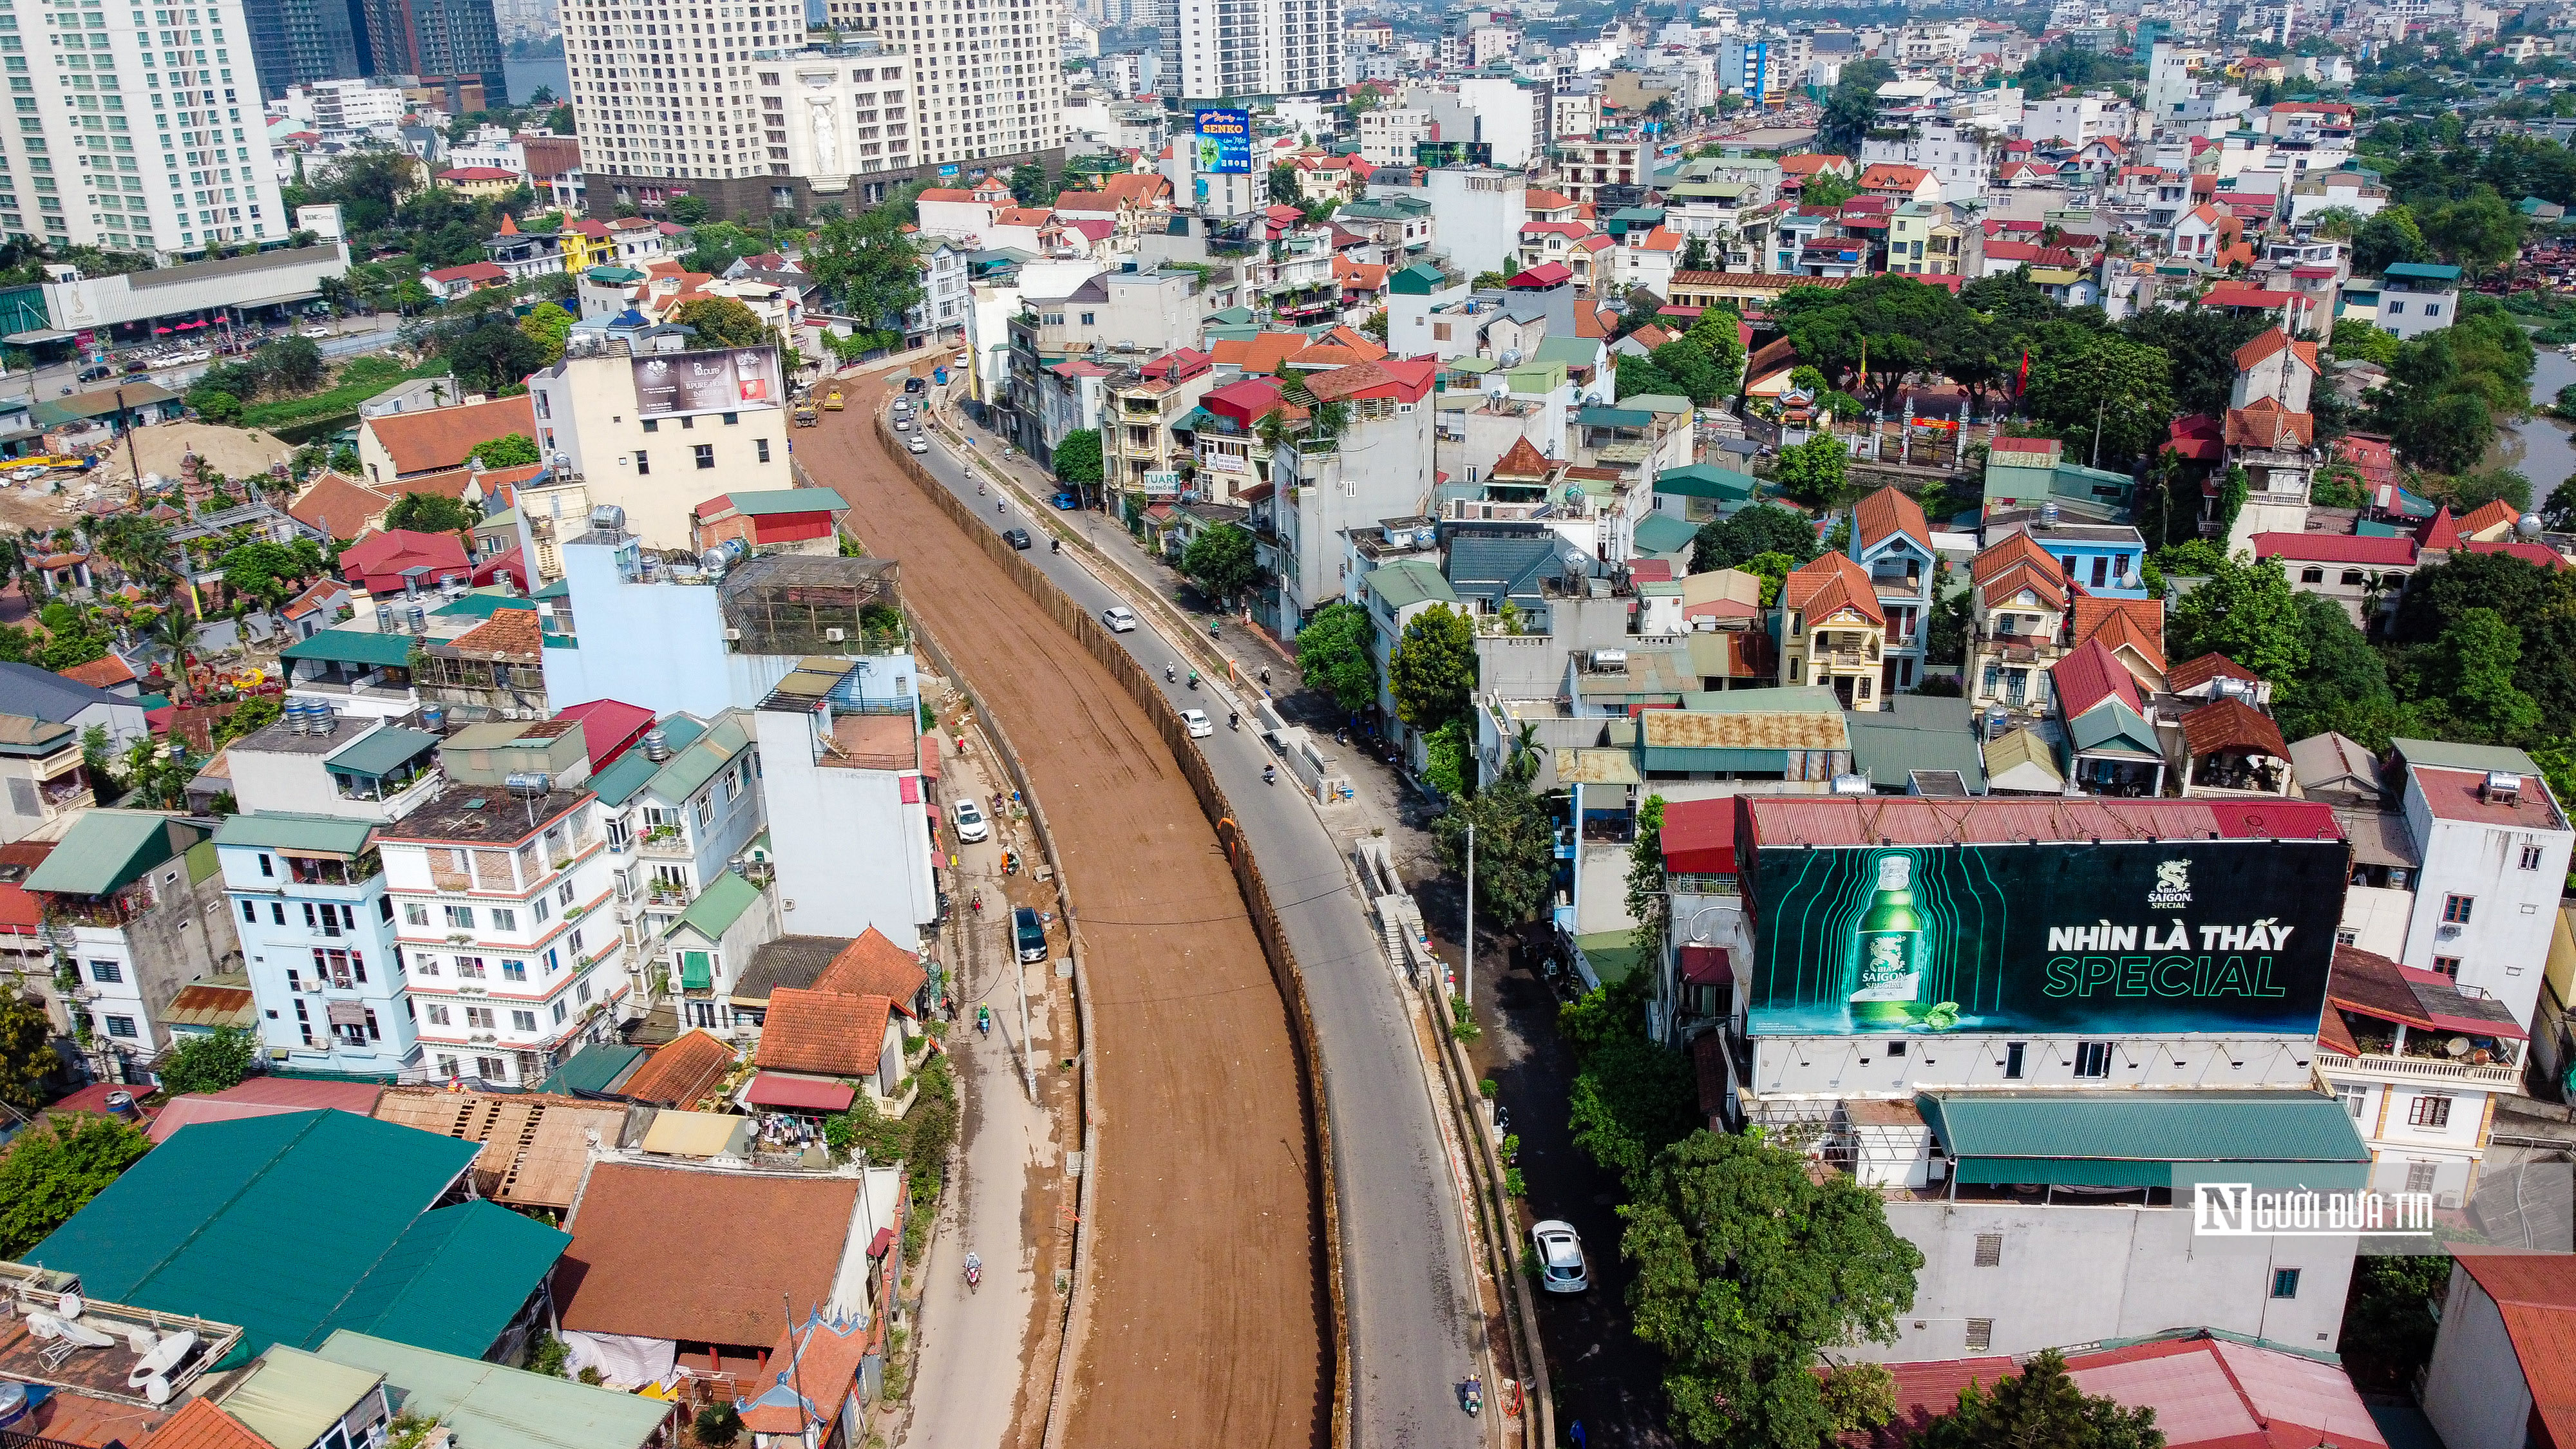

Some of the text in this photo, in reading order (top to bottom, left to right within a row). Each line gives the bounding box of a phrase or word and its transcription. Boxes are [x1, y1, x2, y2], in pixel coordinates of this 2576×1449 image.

[1203, 124, 1243, 133] SENKO
[1144, 474, 1180, 484] TUART
[2048, 917, 2294, 951] NHÌN LÀ THẤY
[1862, 972, 1906, 982] SAIGON
[2042, 956, 2286, 997] SPECIAL
